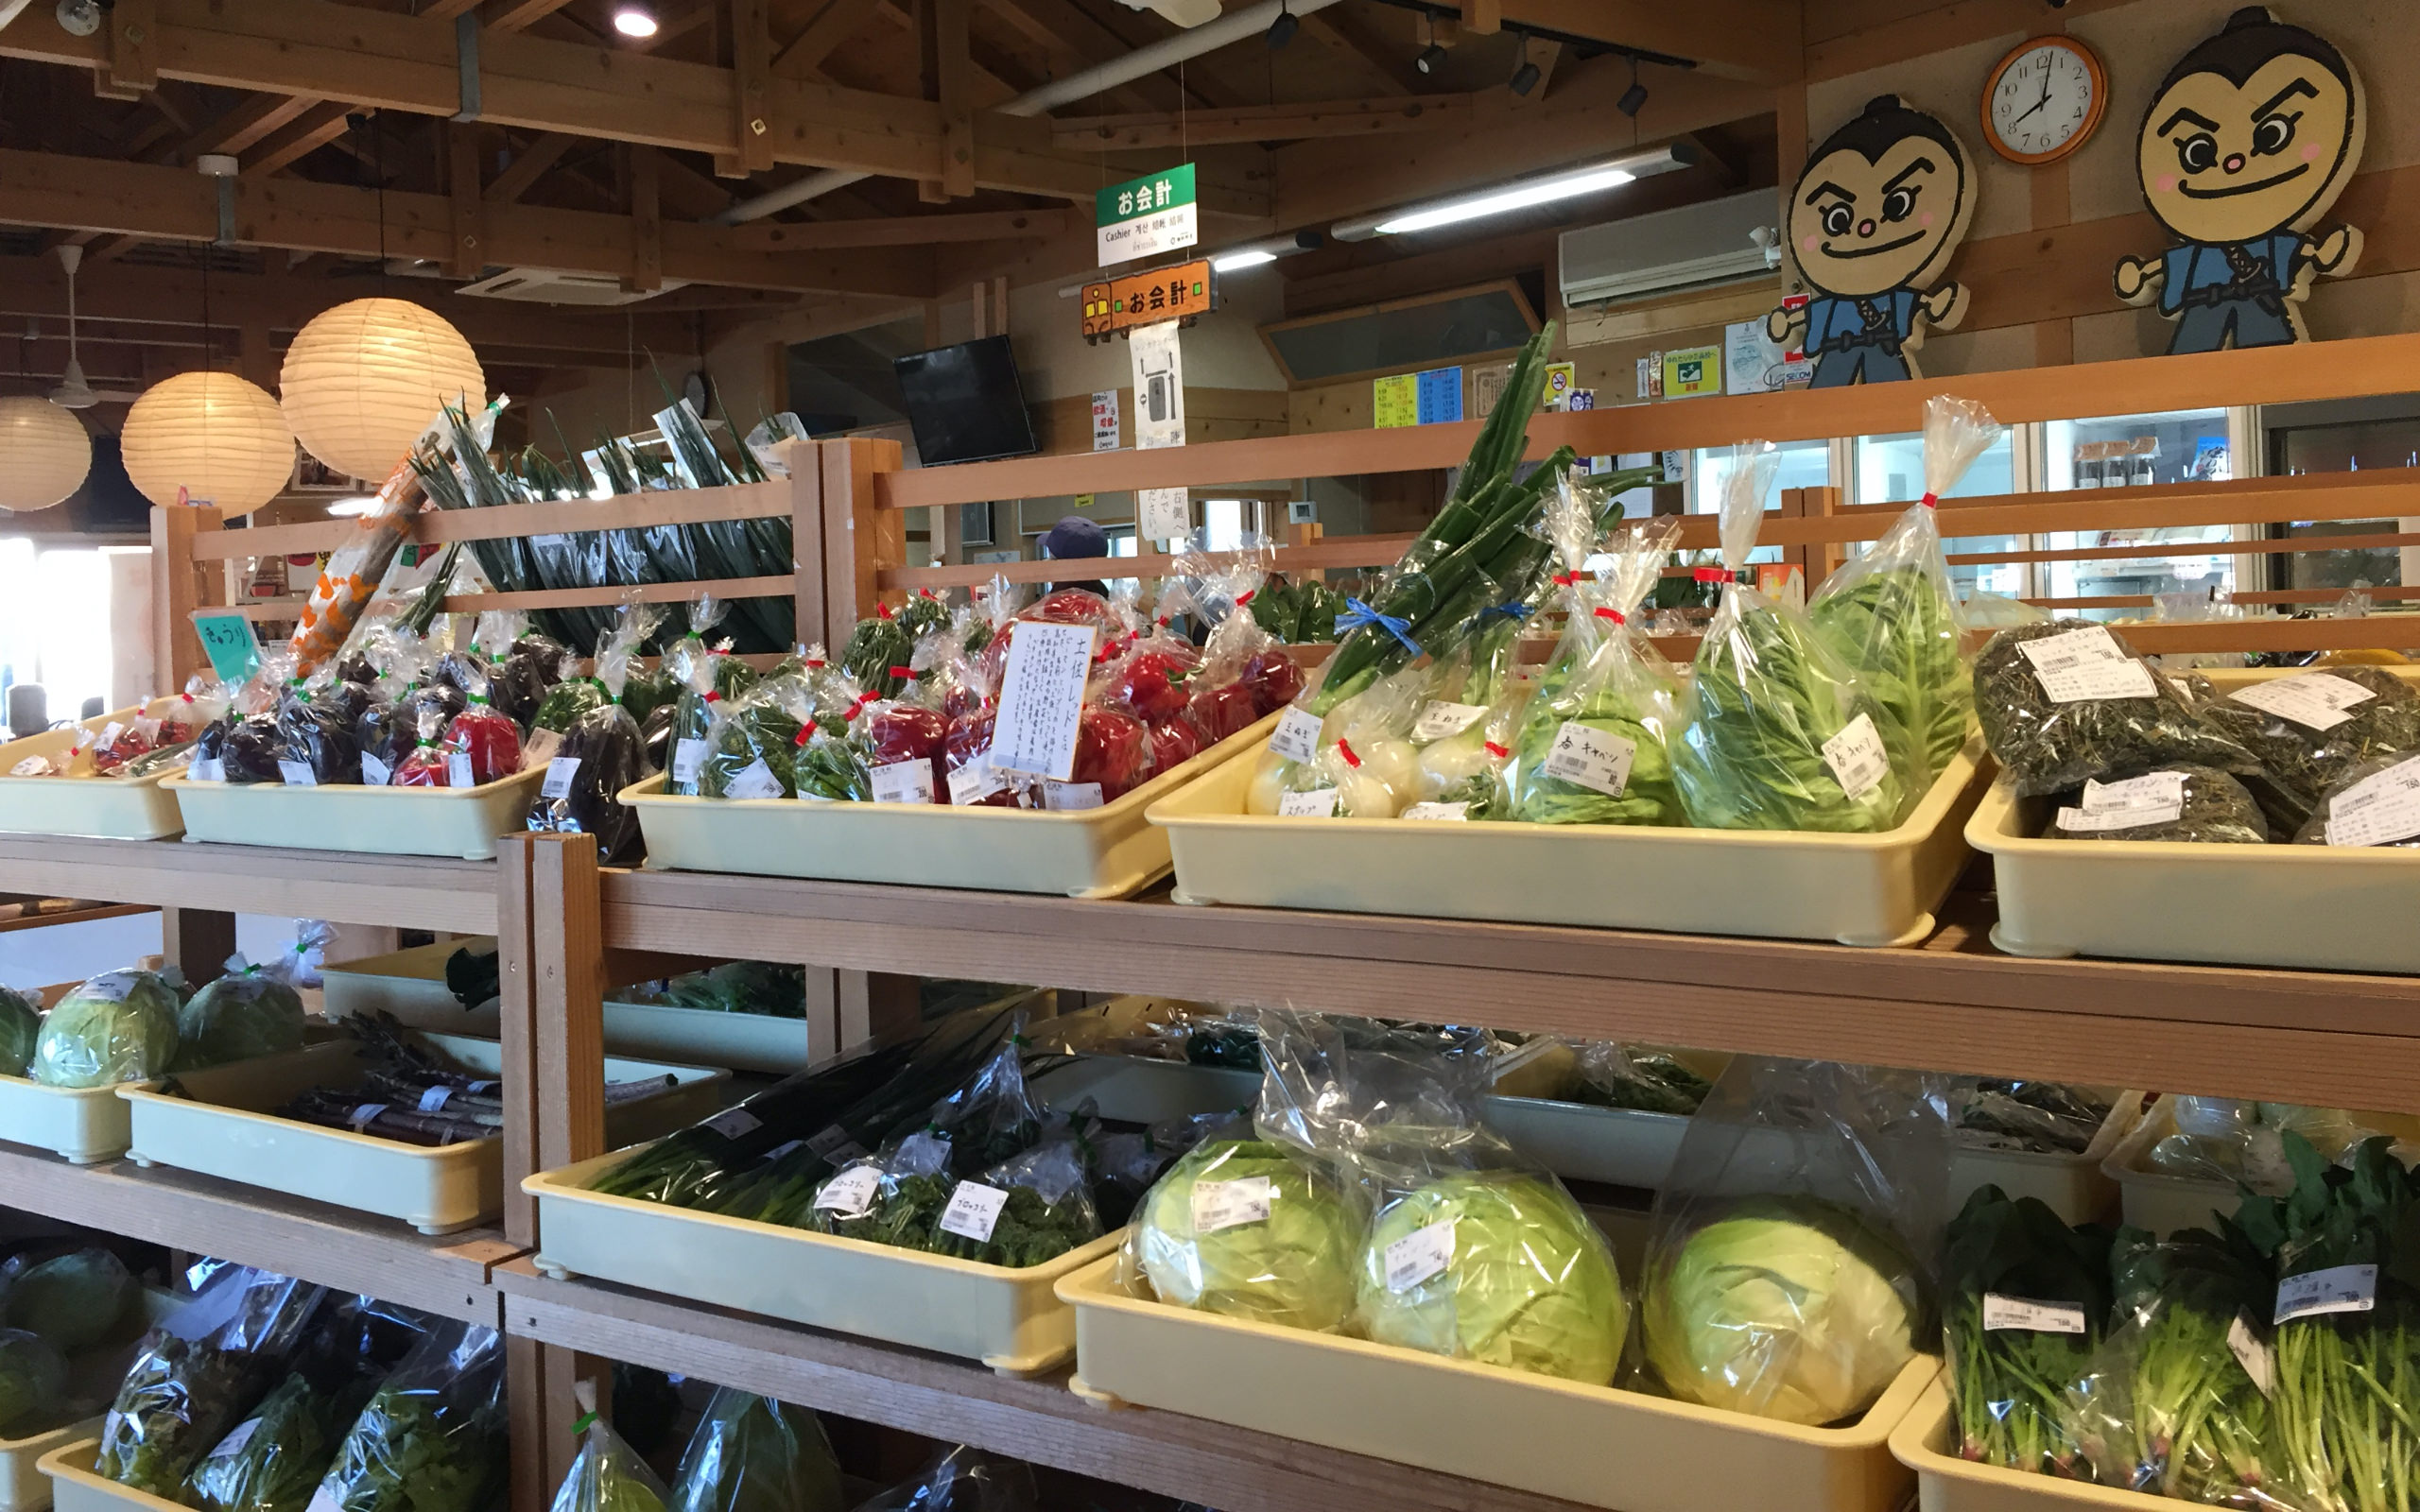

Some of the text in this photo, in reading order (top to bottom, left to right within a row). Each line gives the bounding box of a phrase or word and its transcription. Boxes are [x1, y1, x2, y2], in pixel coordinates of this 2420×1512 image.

[2036, 55, 2050, 70] 12
[2018, 66, 2028, 78] 11
[2073, 66, 2083, 80] 2
[2004, 82, 2017, 97] 10
[2078, 85, 2088, 100] 3
[2001, 103, 2012, 117] 9
[2072, 106, 2083, 119] 4
[2007, 121, 2017, 135] 8
[2061, 124, 2070, 139] 5
[2022, 132, 2031, 146] 7
[2040, 132, 2050, 147] 6
[1118, 179, 1172, 215] お会計
[1105, 228, 1131, 242] Cashier
[1130, 279, 1187, 314] お会計
[1786, 370, 1810, 380] SECOM
[205, 624, 247, 647] きゅうり
[1558, 735, 1618, 764] 春キャベツ
